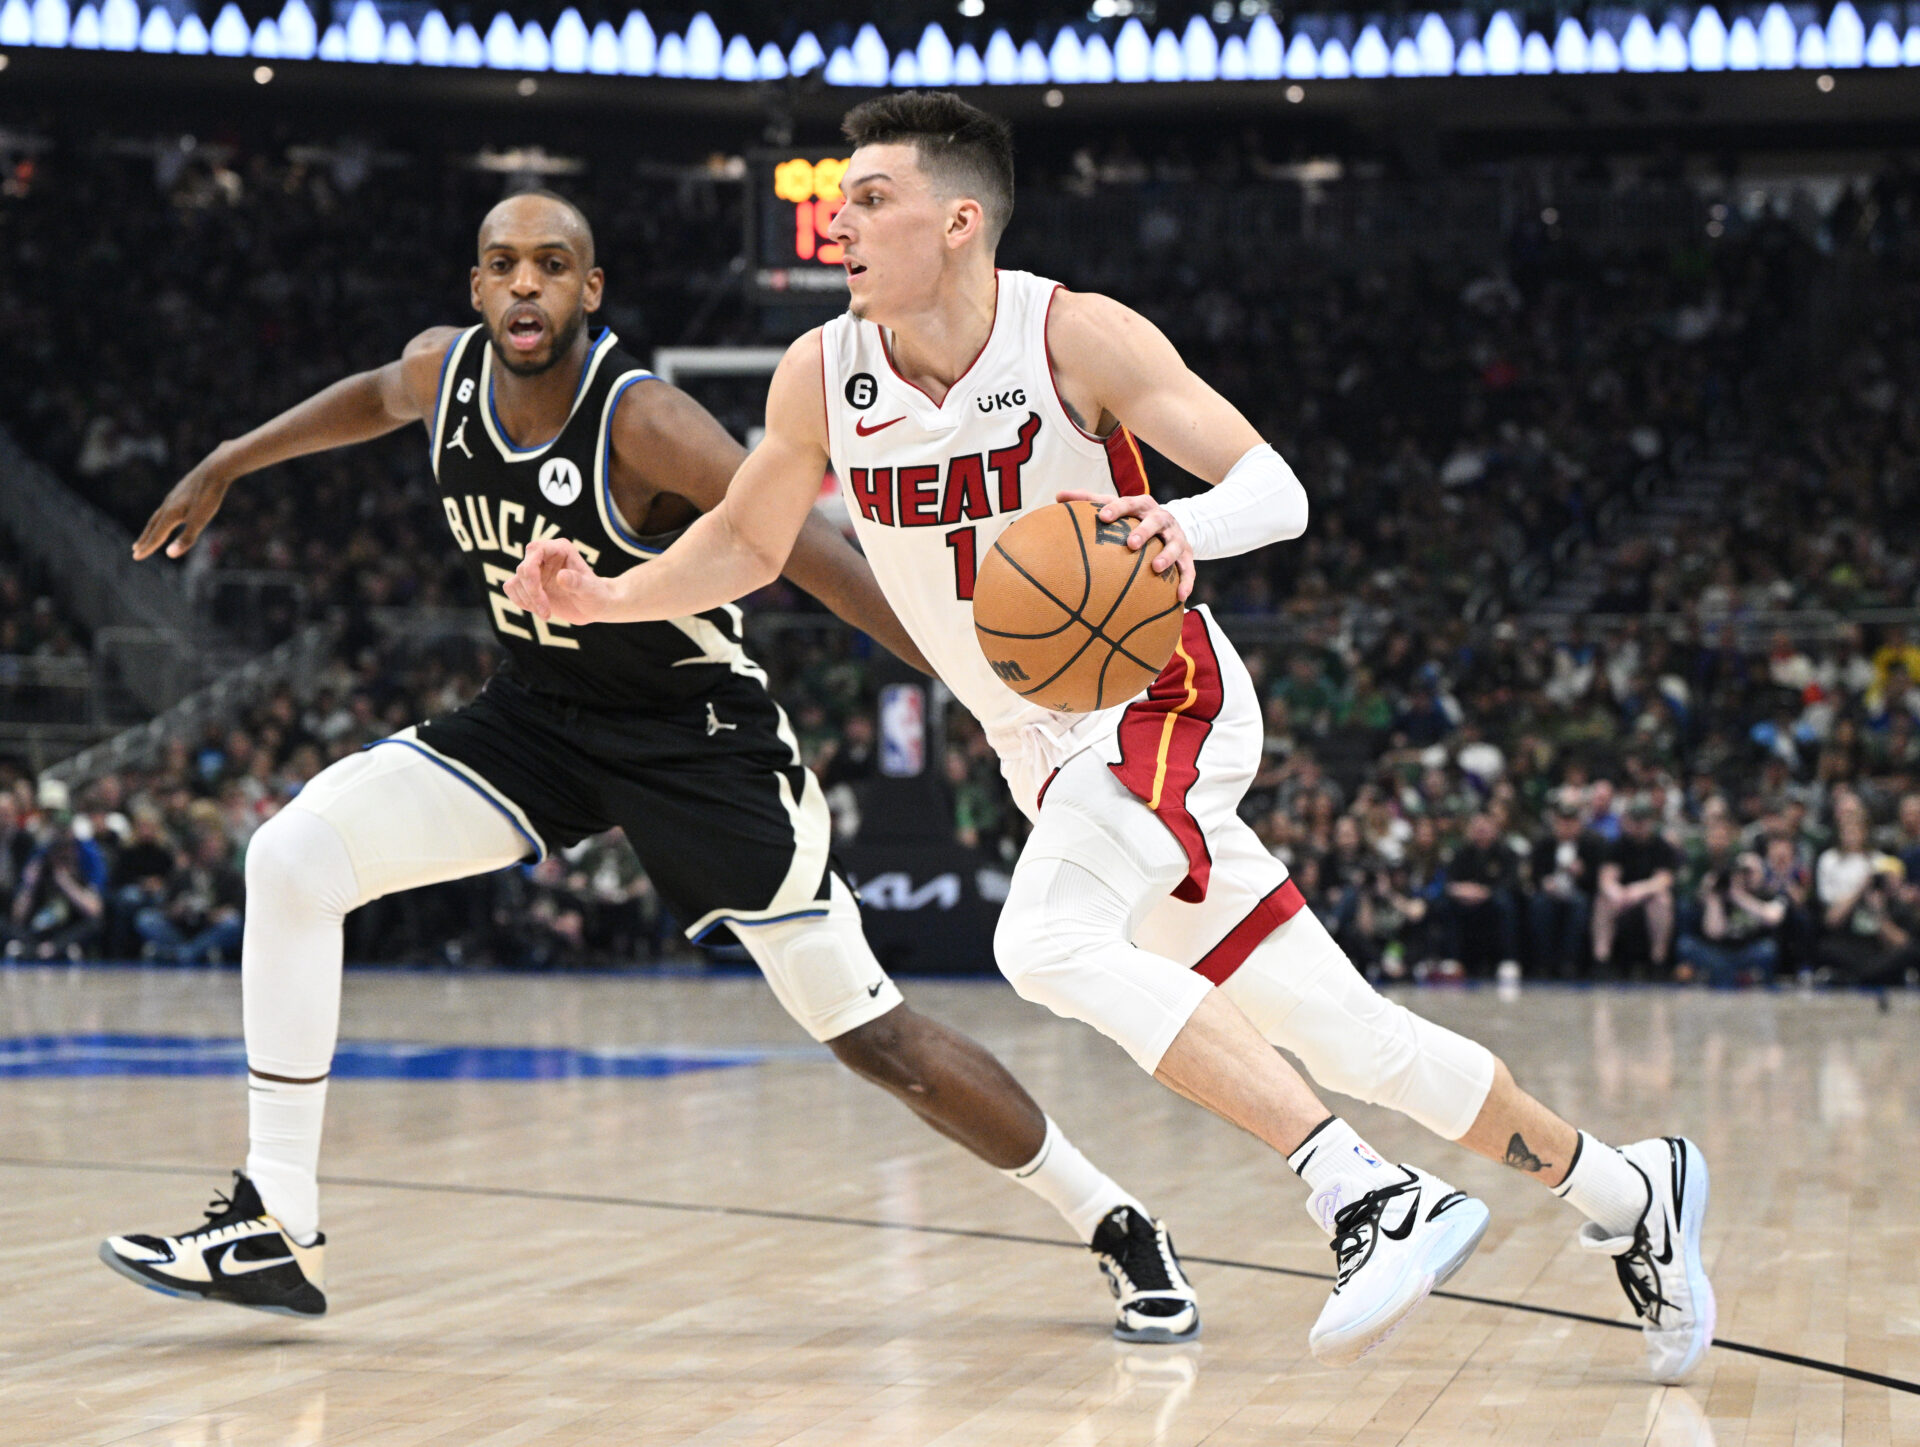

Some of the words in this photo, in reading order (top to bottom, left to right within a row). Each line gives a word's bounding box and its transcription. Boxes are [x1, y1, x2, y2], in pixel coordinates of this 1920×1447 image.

[456, 377, 475, 404] 6
[853, 377, 873, 406] 6
[849, 411, 1042, 528] HEAT
